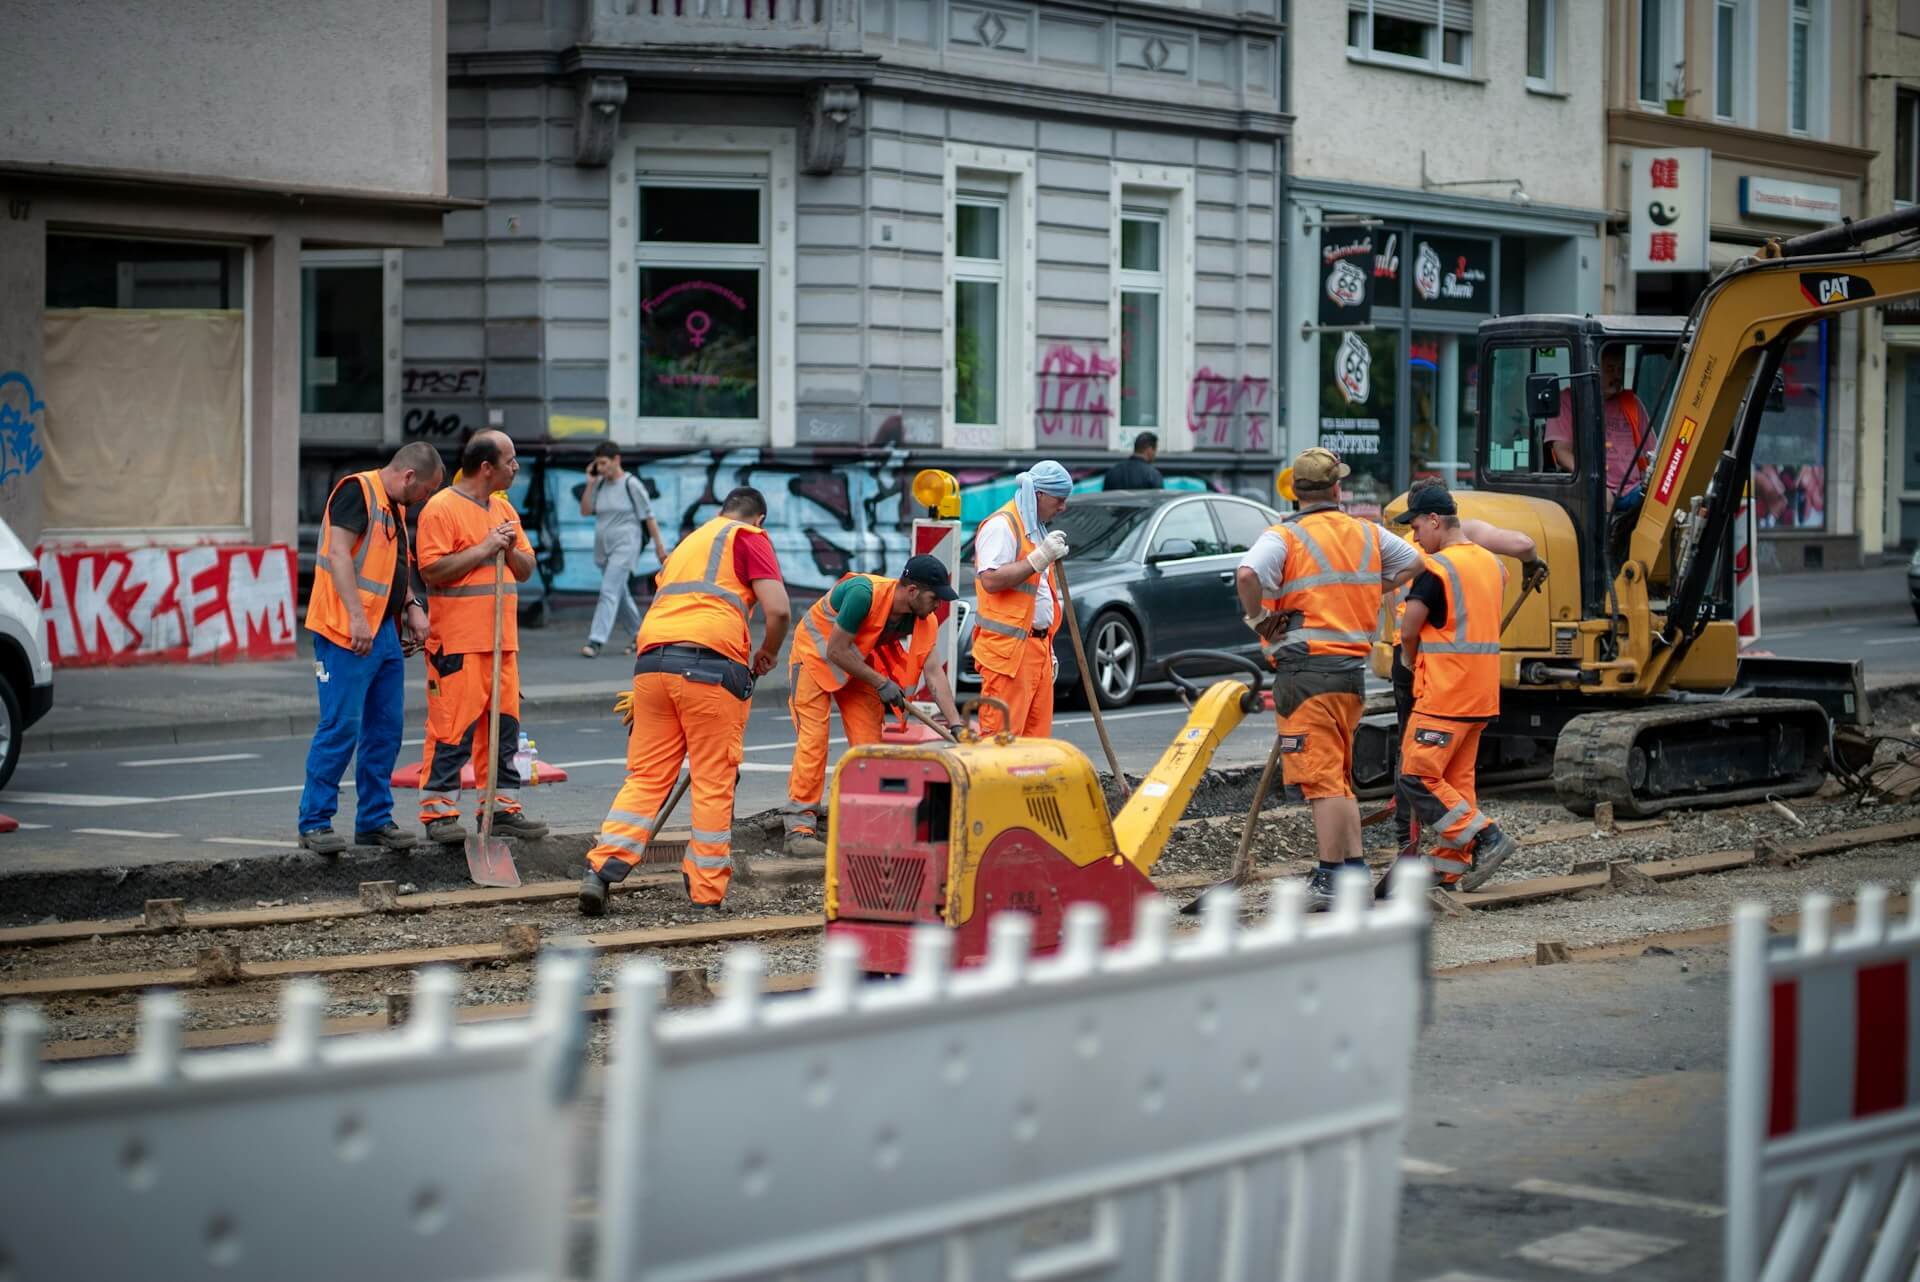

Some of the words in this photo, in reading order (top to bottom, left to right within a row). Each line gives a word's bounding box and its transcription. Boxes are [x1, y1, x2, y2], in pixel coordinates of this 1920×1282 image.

[1819, 275, 1850, 304] CAT
[1346, 353, 1363, 383] 66
[1661, 447, 1683, 496] ZEPPELIN
